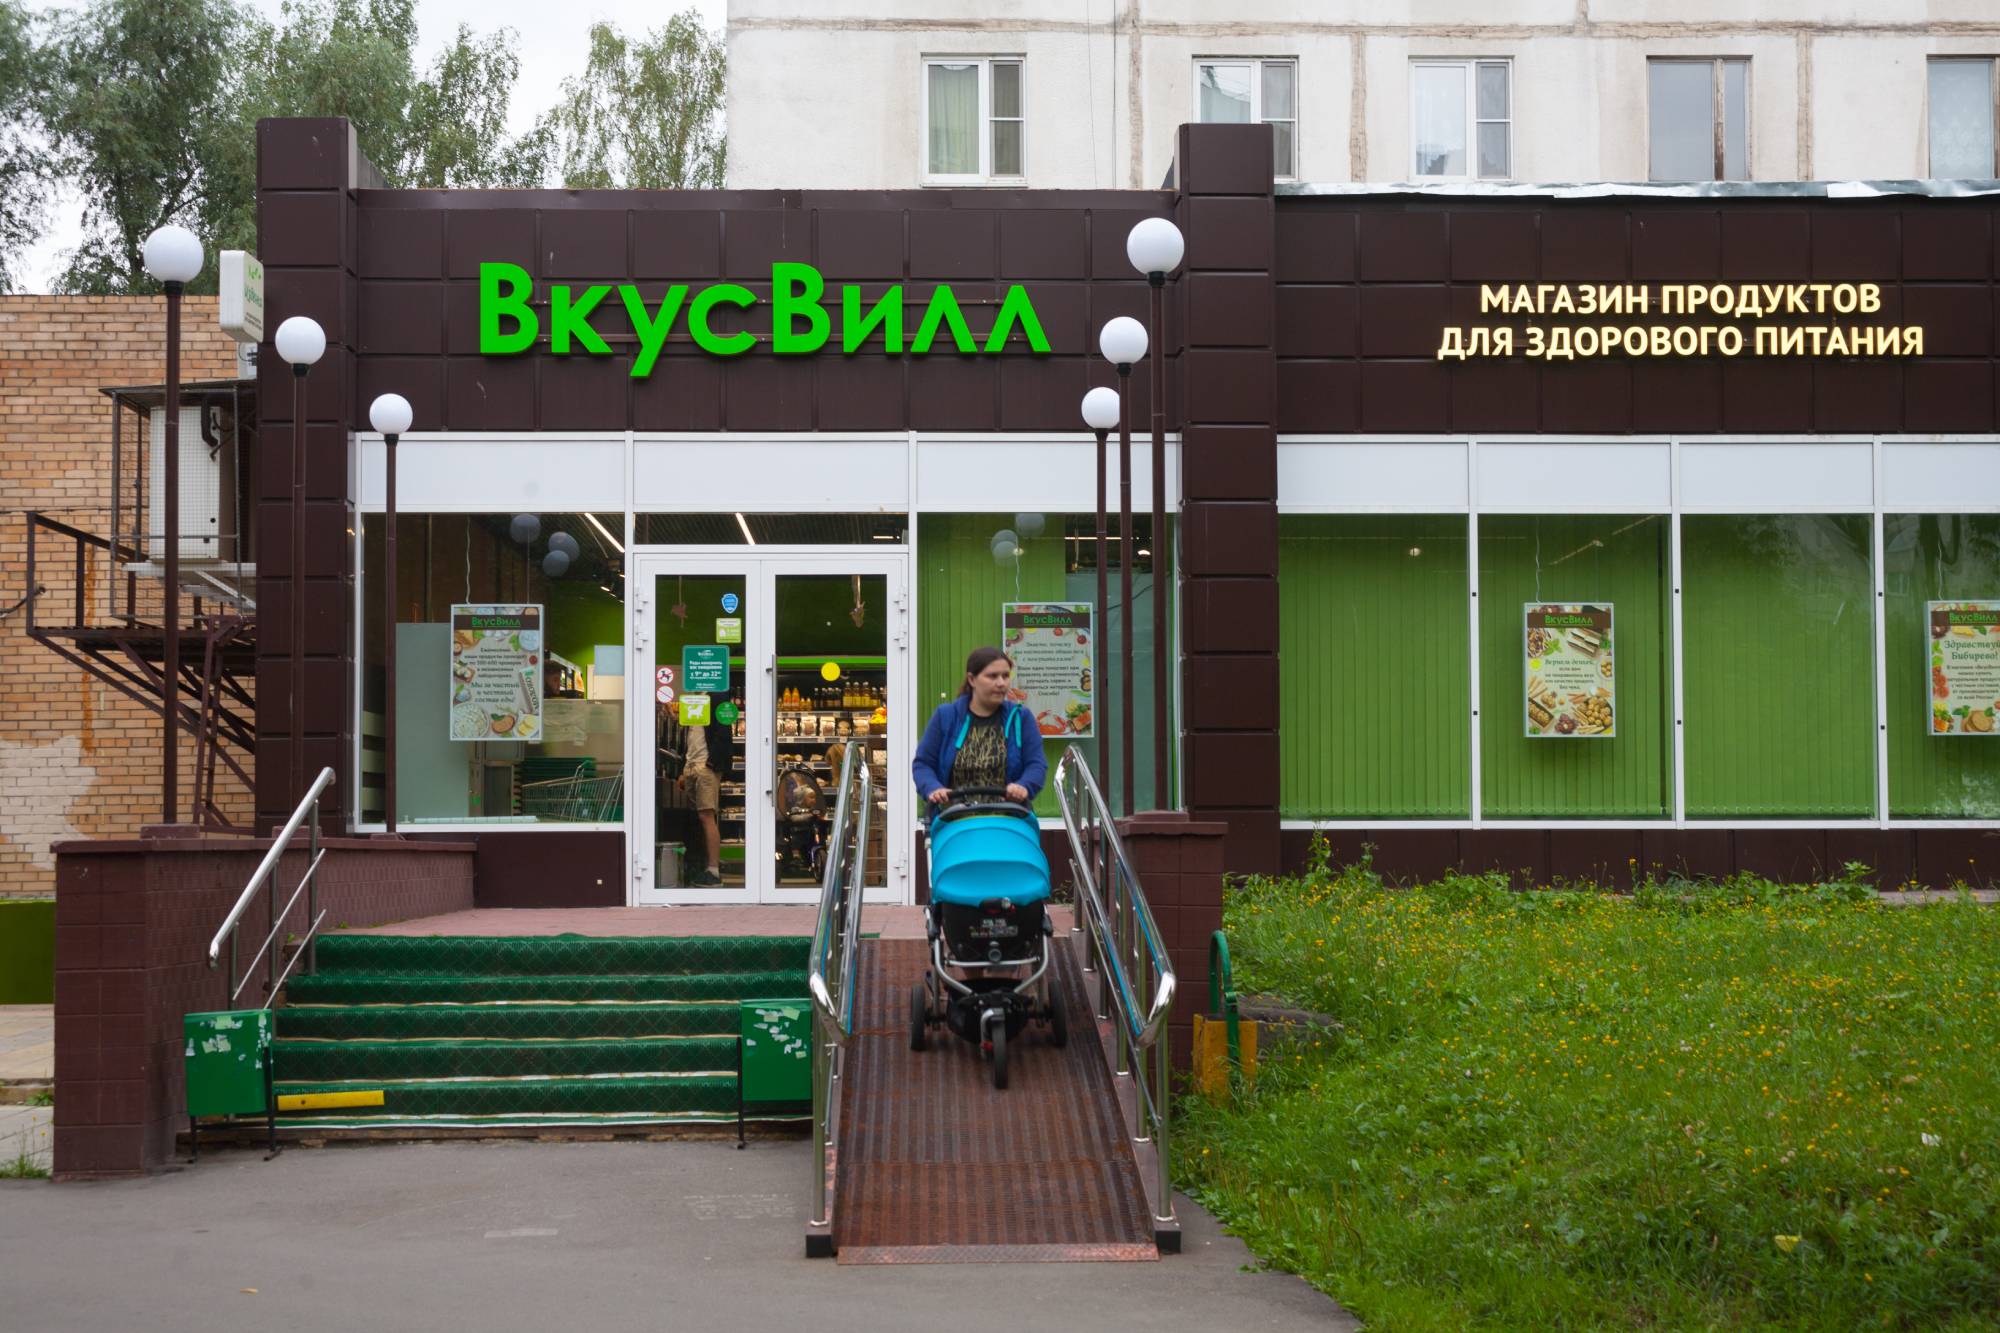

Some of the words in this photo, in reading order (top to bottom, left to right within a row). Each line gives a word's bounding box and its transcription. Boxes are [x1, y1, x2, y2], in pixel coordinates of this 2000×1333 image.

[1480, 284, 1649, 314] МАГАЗИН
[1661, 283, 1881, 318] ПРОДУКТОВ
[479, 261, 1052, 379] ВкусВилл
[1437, 326, 1513, 360] ДЛЯ
[1524, 325, 1744, 360] ЗДОРОВОГО
[1755, 326, 1924, 356] ПИТАНИЯ
[472, 616, 521, 626] ВкусВилл
[1023, 615, 1072, 625] ВкусВилл
[1544, 615, 1593, 625] ВкусВилл
